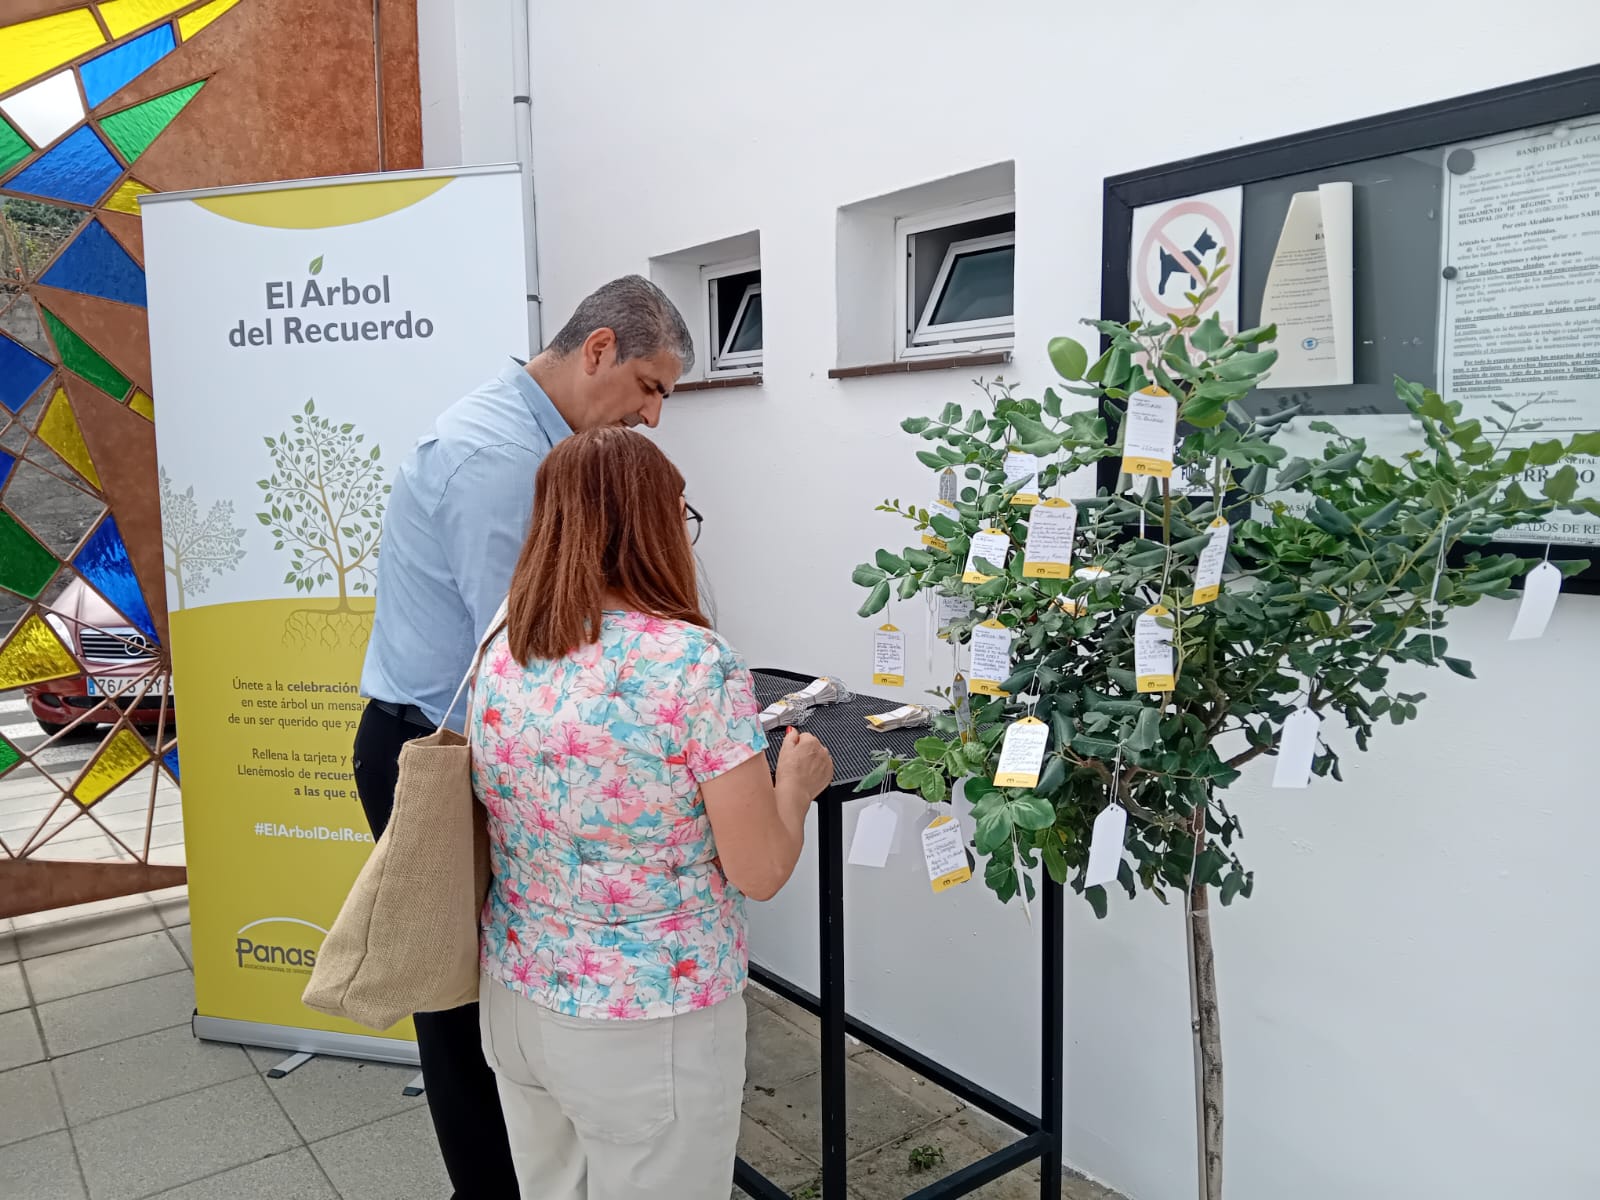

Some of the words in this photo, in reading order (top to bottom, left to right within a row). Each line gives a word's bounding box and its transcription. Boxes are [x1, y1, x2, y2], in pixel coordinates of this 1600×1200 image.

[266, 281, 293, 309] El
[229, 318, 272, 347] del
[284, 310, 433, 344] Recuerdo
[1562, 524, 1580, 533] DE
[232, 676, 263, 690] Únete
[266, 683, 272, 691] a
[276, 680, 283, 691] la
[287, 681, 358, 693] celebración
[242, 699, 253, 707] en
[257, 699, 277, 708] este
[281, 698, 307, 709] árbol
[312, 702, 324, 710] un
[228, 713, 240, 724] de
[244, 717, 256, 725] un
[259, 717, 275, 725] ser
[278, 716, 318, 729] querido
[322, 719, 342, 731] que
[346, 720, 356, 732] ya
[252, 748, 288, 760] Rellena
[292, 750, 299, 761] la
[304, 752, 337, 765] tarjeta
[341, 756, 347, 766] y
[238, 764, 294, 777] Llenémoslo
[298, 768, 310, 779] de
[294, 787, 300, 796] a
[304, 786, 320, 796] las
[324, 789, 346, 801] que
[350, 790, 360, 801] q
